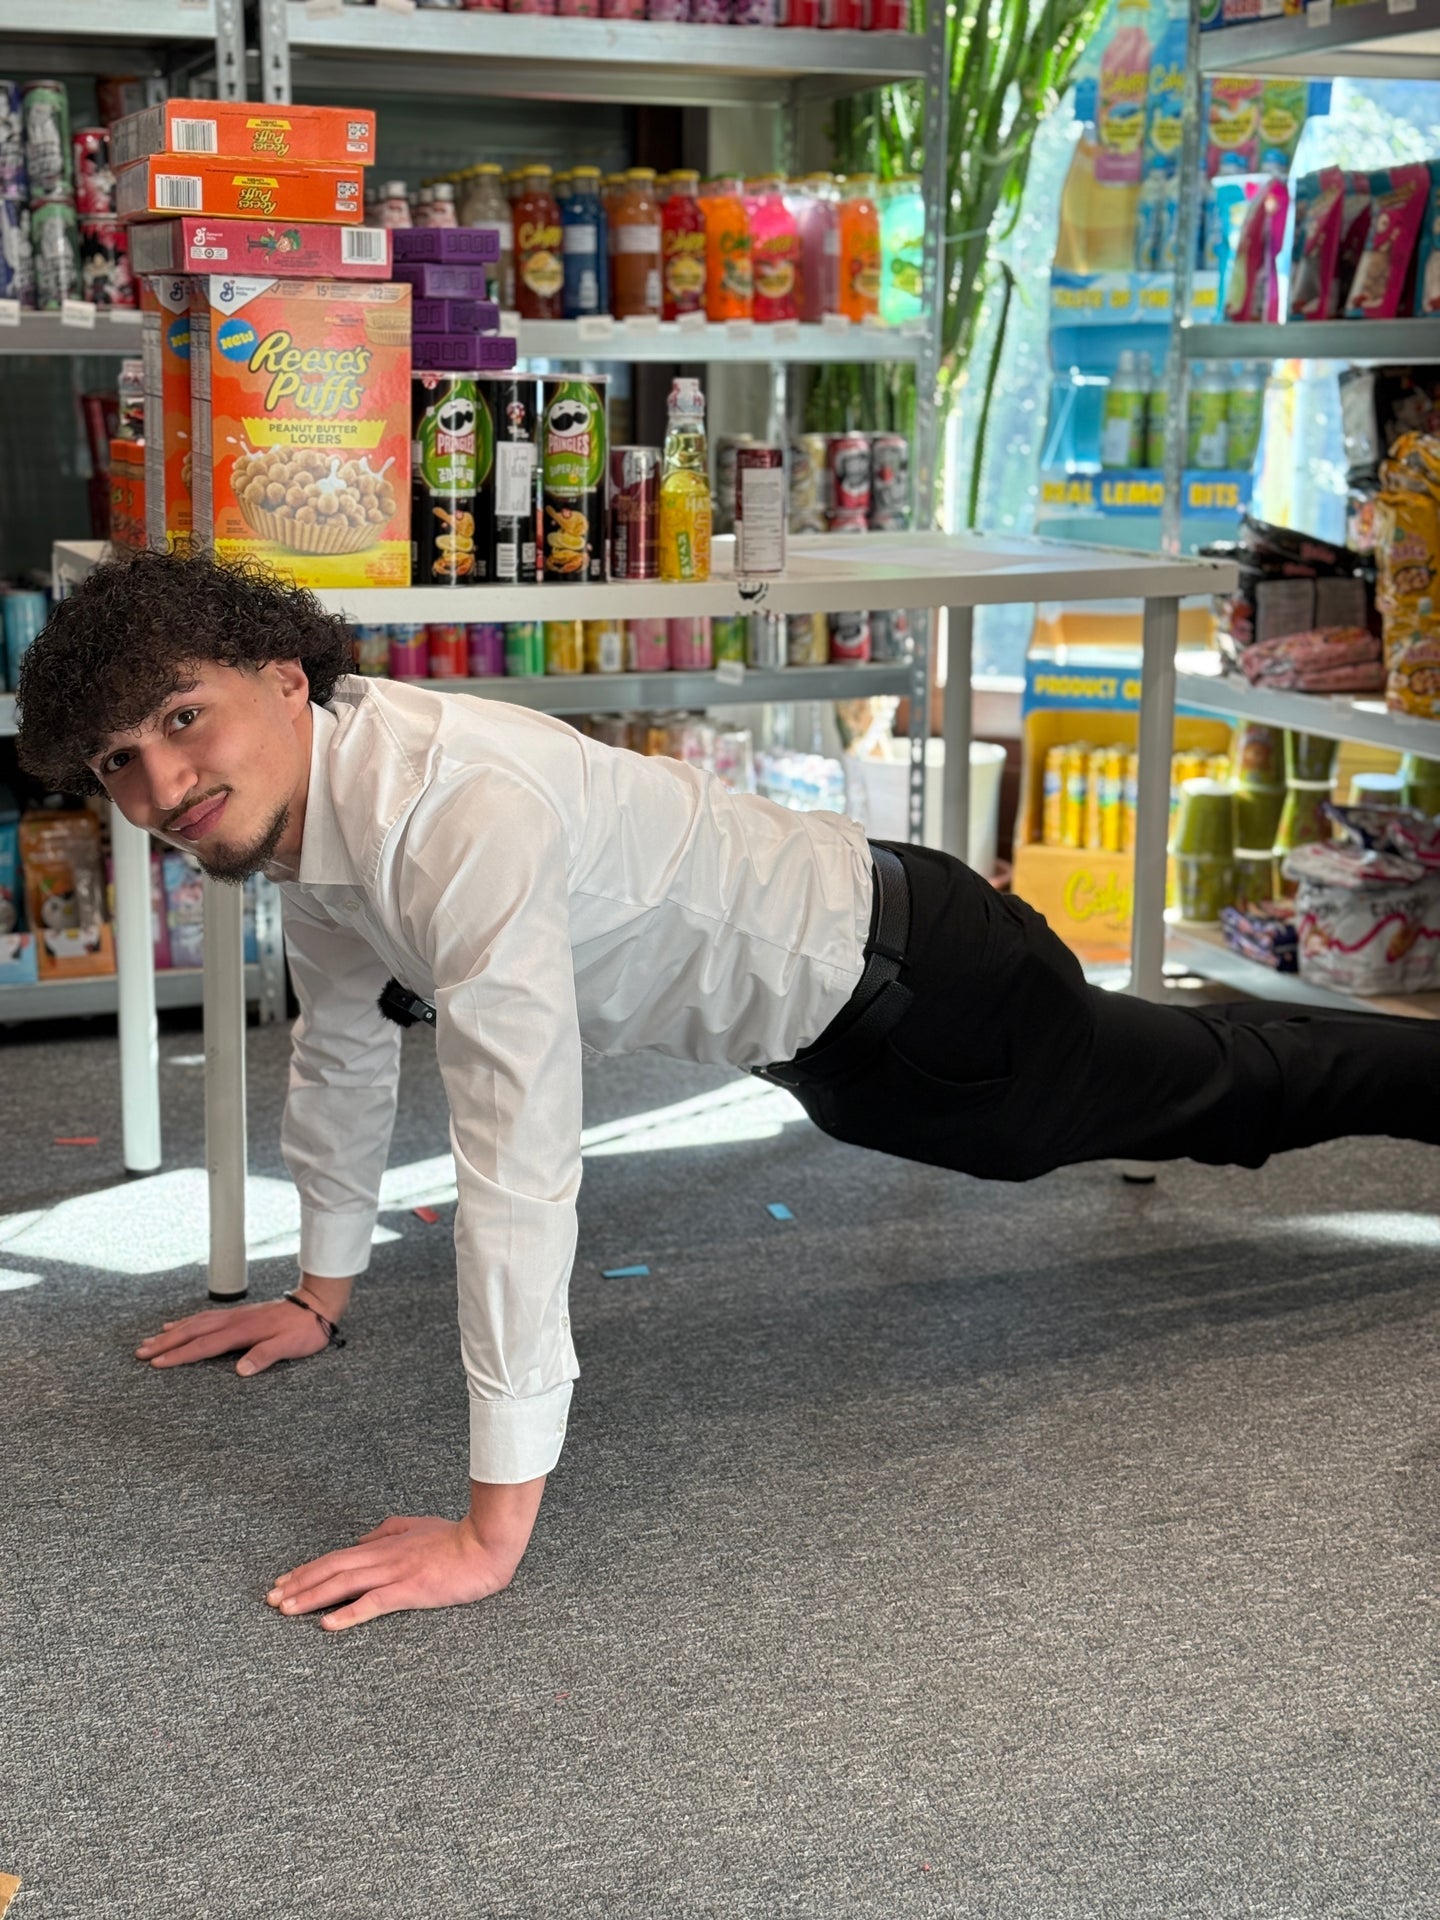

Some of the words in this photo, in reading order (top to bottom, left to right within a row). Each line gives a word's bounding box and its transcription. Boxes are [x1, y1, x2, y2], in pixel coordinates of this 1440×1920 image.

[240, 187, 272, 202] Puffs
[249, 330, 373, 374] Reese's
[264, 371, 365, 418] Puffs
[268, 423, 312, 433] PEANUT
[316, 426, 358, 434] BUTTER
[290, 434, 342, 444] LOVERS
[548, 432, 590, 457] PRINGLES
[1042, 481, 1093, 504] REAL
[1101, 482, 1165, 506] LEMO
[1189, 483, 1240, 507] BITS
[1033, 673, 1117, 698] PRODUCT
[1121, 678, 1142, 699] O
[1063, 868, 1133, 923] Caly
